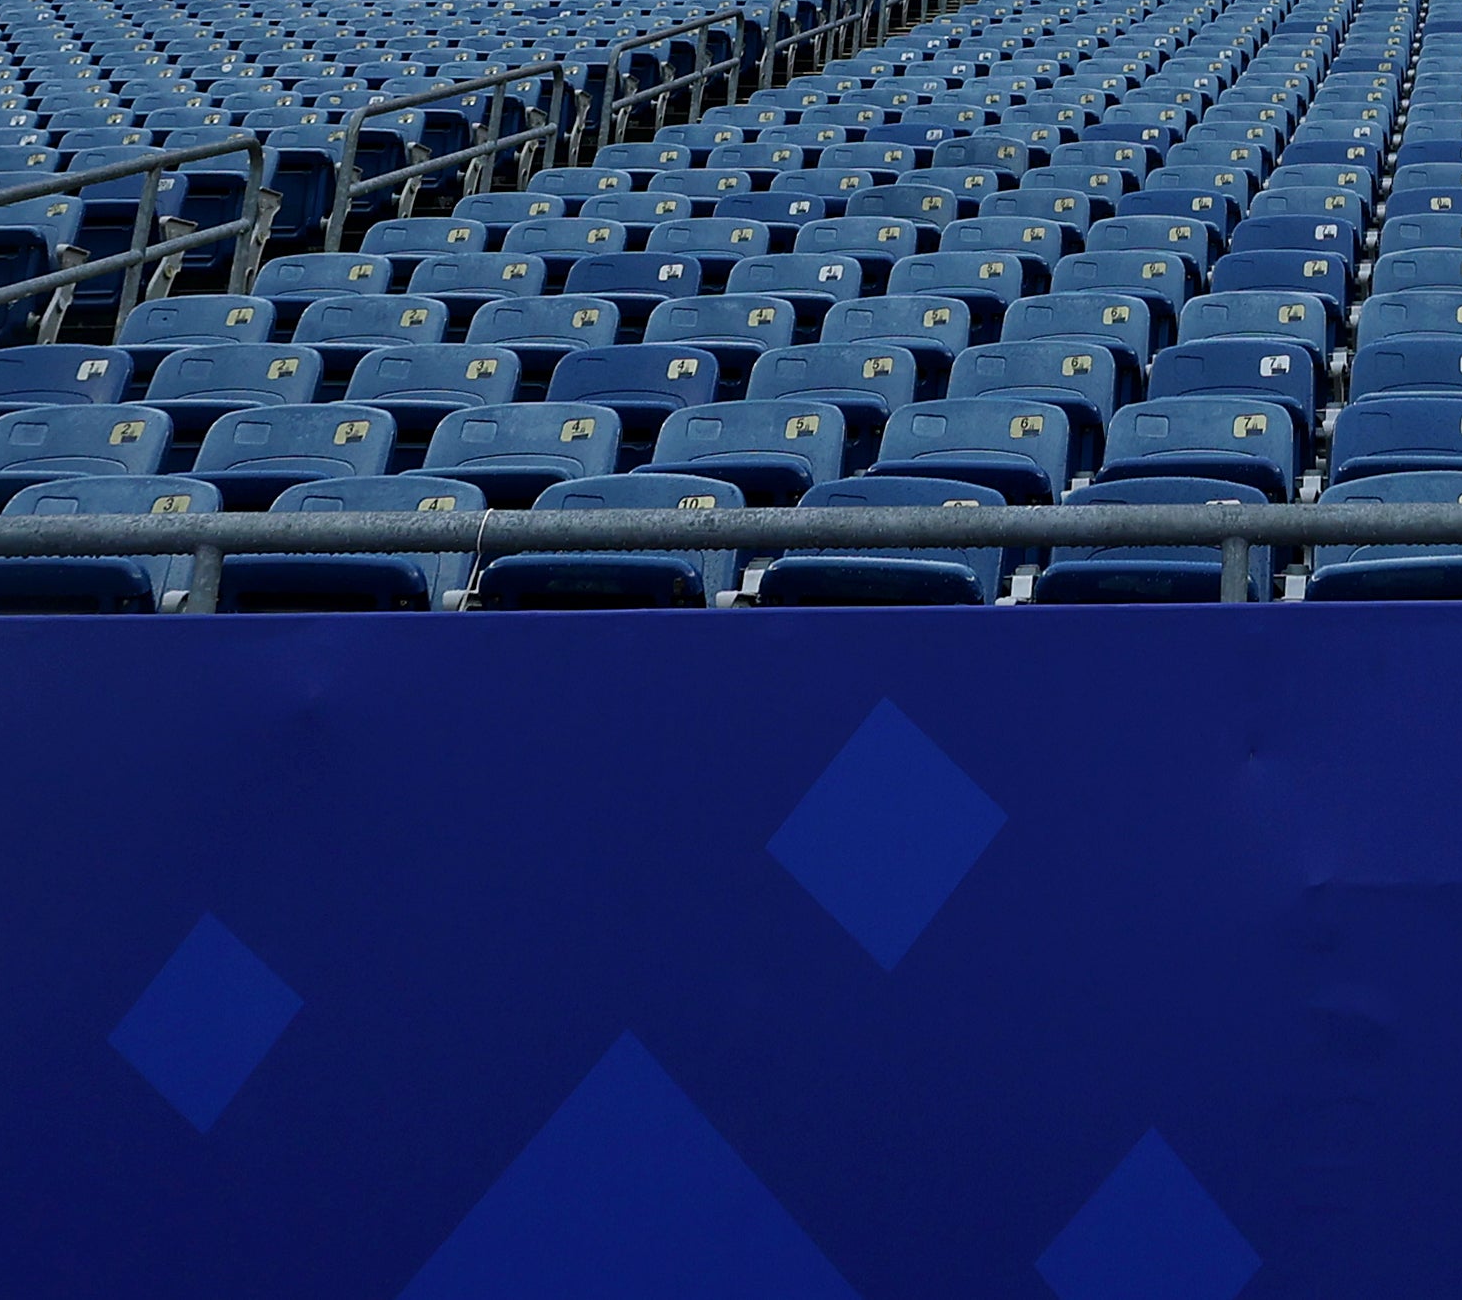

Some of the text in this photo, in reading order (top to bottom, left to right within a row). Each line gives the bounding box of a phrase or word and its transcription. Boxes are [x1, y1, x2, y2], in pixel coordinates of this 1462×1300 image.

[572, 421, 580, 431] 4
[796, 417, 804, 429] 5
[1020, 418, 1028, 429] 6
[1244, 417, 1252, 428] 7
[121, 423, 130, 434] 2
[345, 424, 354, 435] 3
[164, 498, 172, 510] 3
[429, 499, 438, 510] 4
[682, 498, 699, 509] 10
